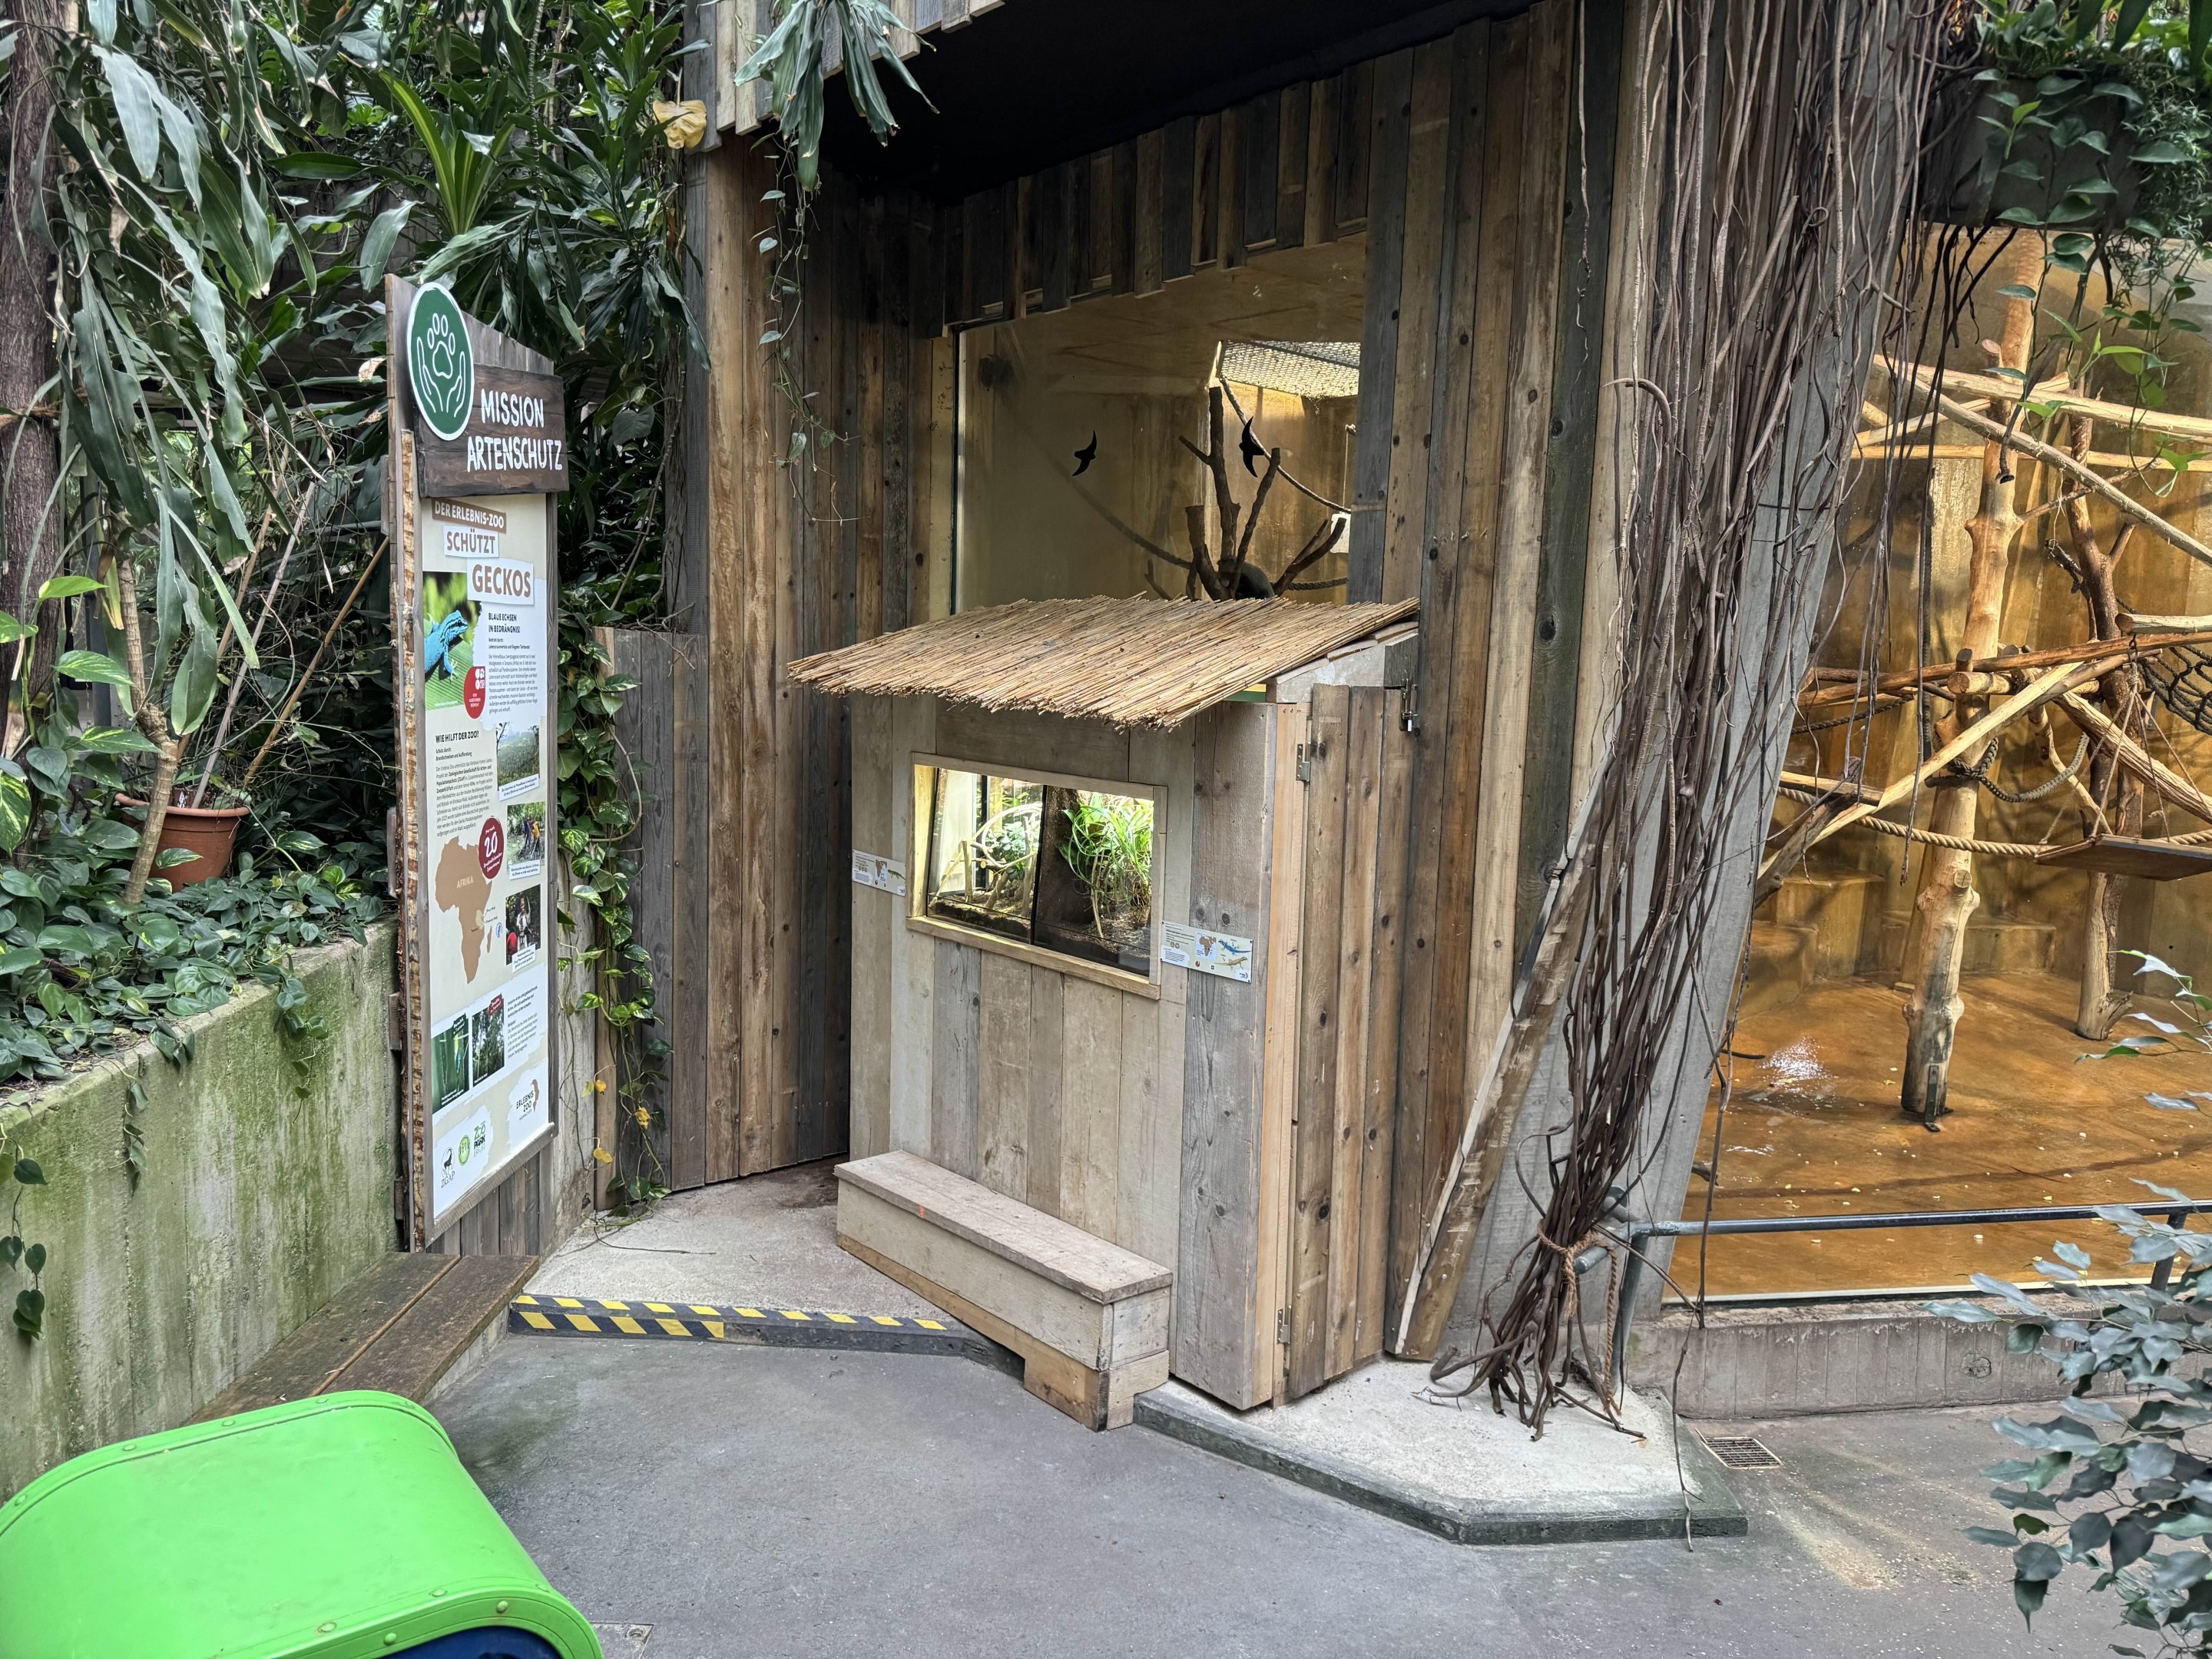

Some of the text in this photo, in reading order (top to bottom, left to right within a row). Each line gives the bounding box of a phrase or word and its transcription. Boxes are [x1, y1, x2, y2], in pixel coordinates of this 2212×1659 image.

[481, 388, 545, 429] MISSION
[467, 435, 563, 473] ARTENSCHUTZ
[435, 501, 505, 529] DER ERLEBNIS-ZOO
[446, 528, 496, 555] SCHÜTZT
[472, 564, 531, 598] GECKOS
[488, 613, 517, 622] BLAUE ECHSEN
[488, 623, 521, 634] IN BEDRÄNGNIS!
[435, 730, 479, 743] WIE HILFT DER ZOO?
[484, 831, 498, 858] 20
[456, 876, 474, 889] AFRIKA
[516, 1089, 534, 1110] ERLEBNIS
[523, 1101, 532, 1112] ZOO
[474, 1134, 486, 1150] PARK
